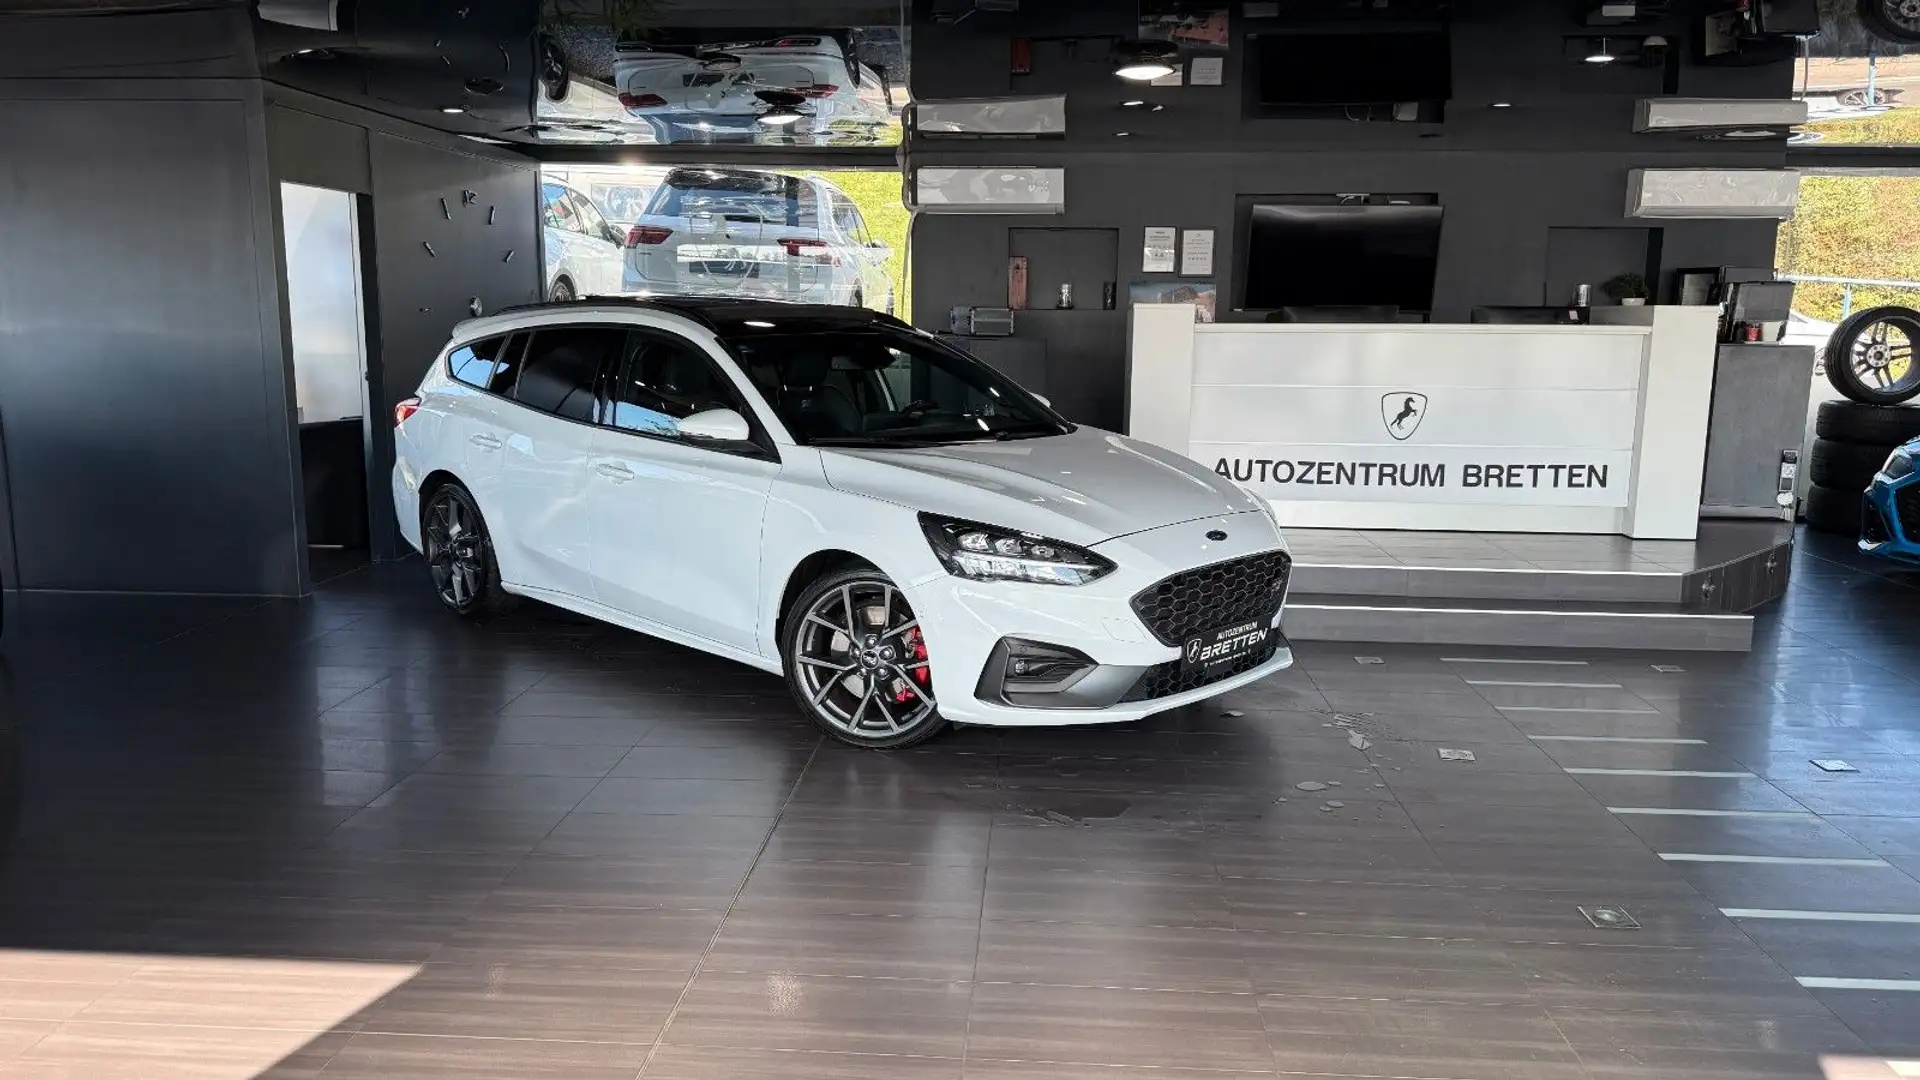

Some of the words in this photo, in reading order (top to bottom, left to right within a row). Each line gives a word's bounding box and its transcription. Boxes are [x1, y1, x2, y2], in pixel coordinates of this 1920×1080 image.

[1215, 457, 1446, 487] AUTOZENTRUM
[1462, 464, 1609, 488] BRETTEN
[1200, 627, 1269, 660] BRETTEN
[1216, 621, 1258, 640] AUTOZENTRUM
